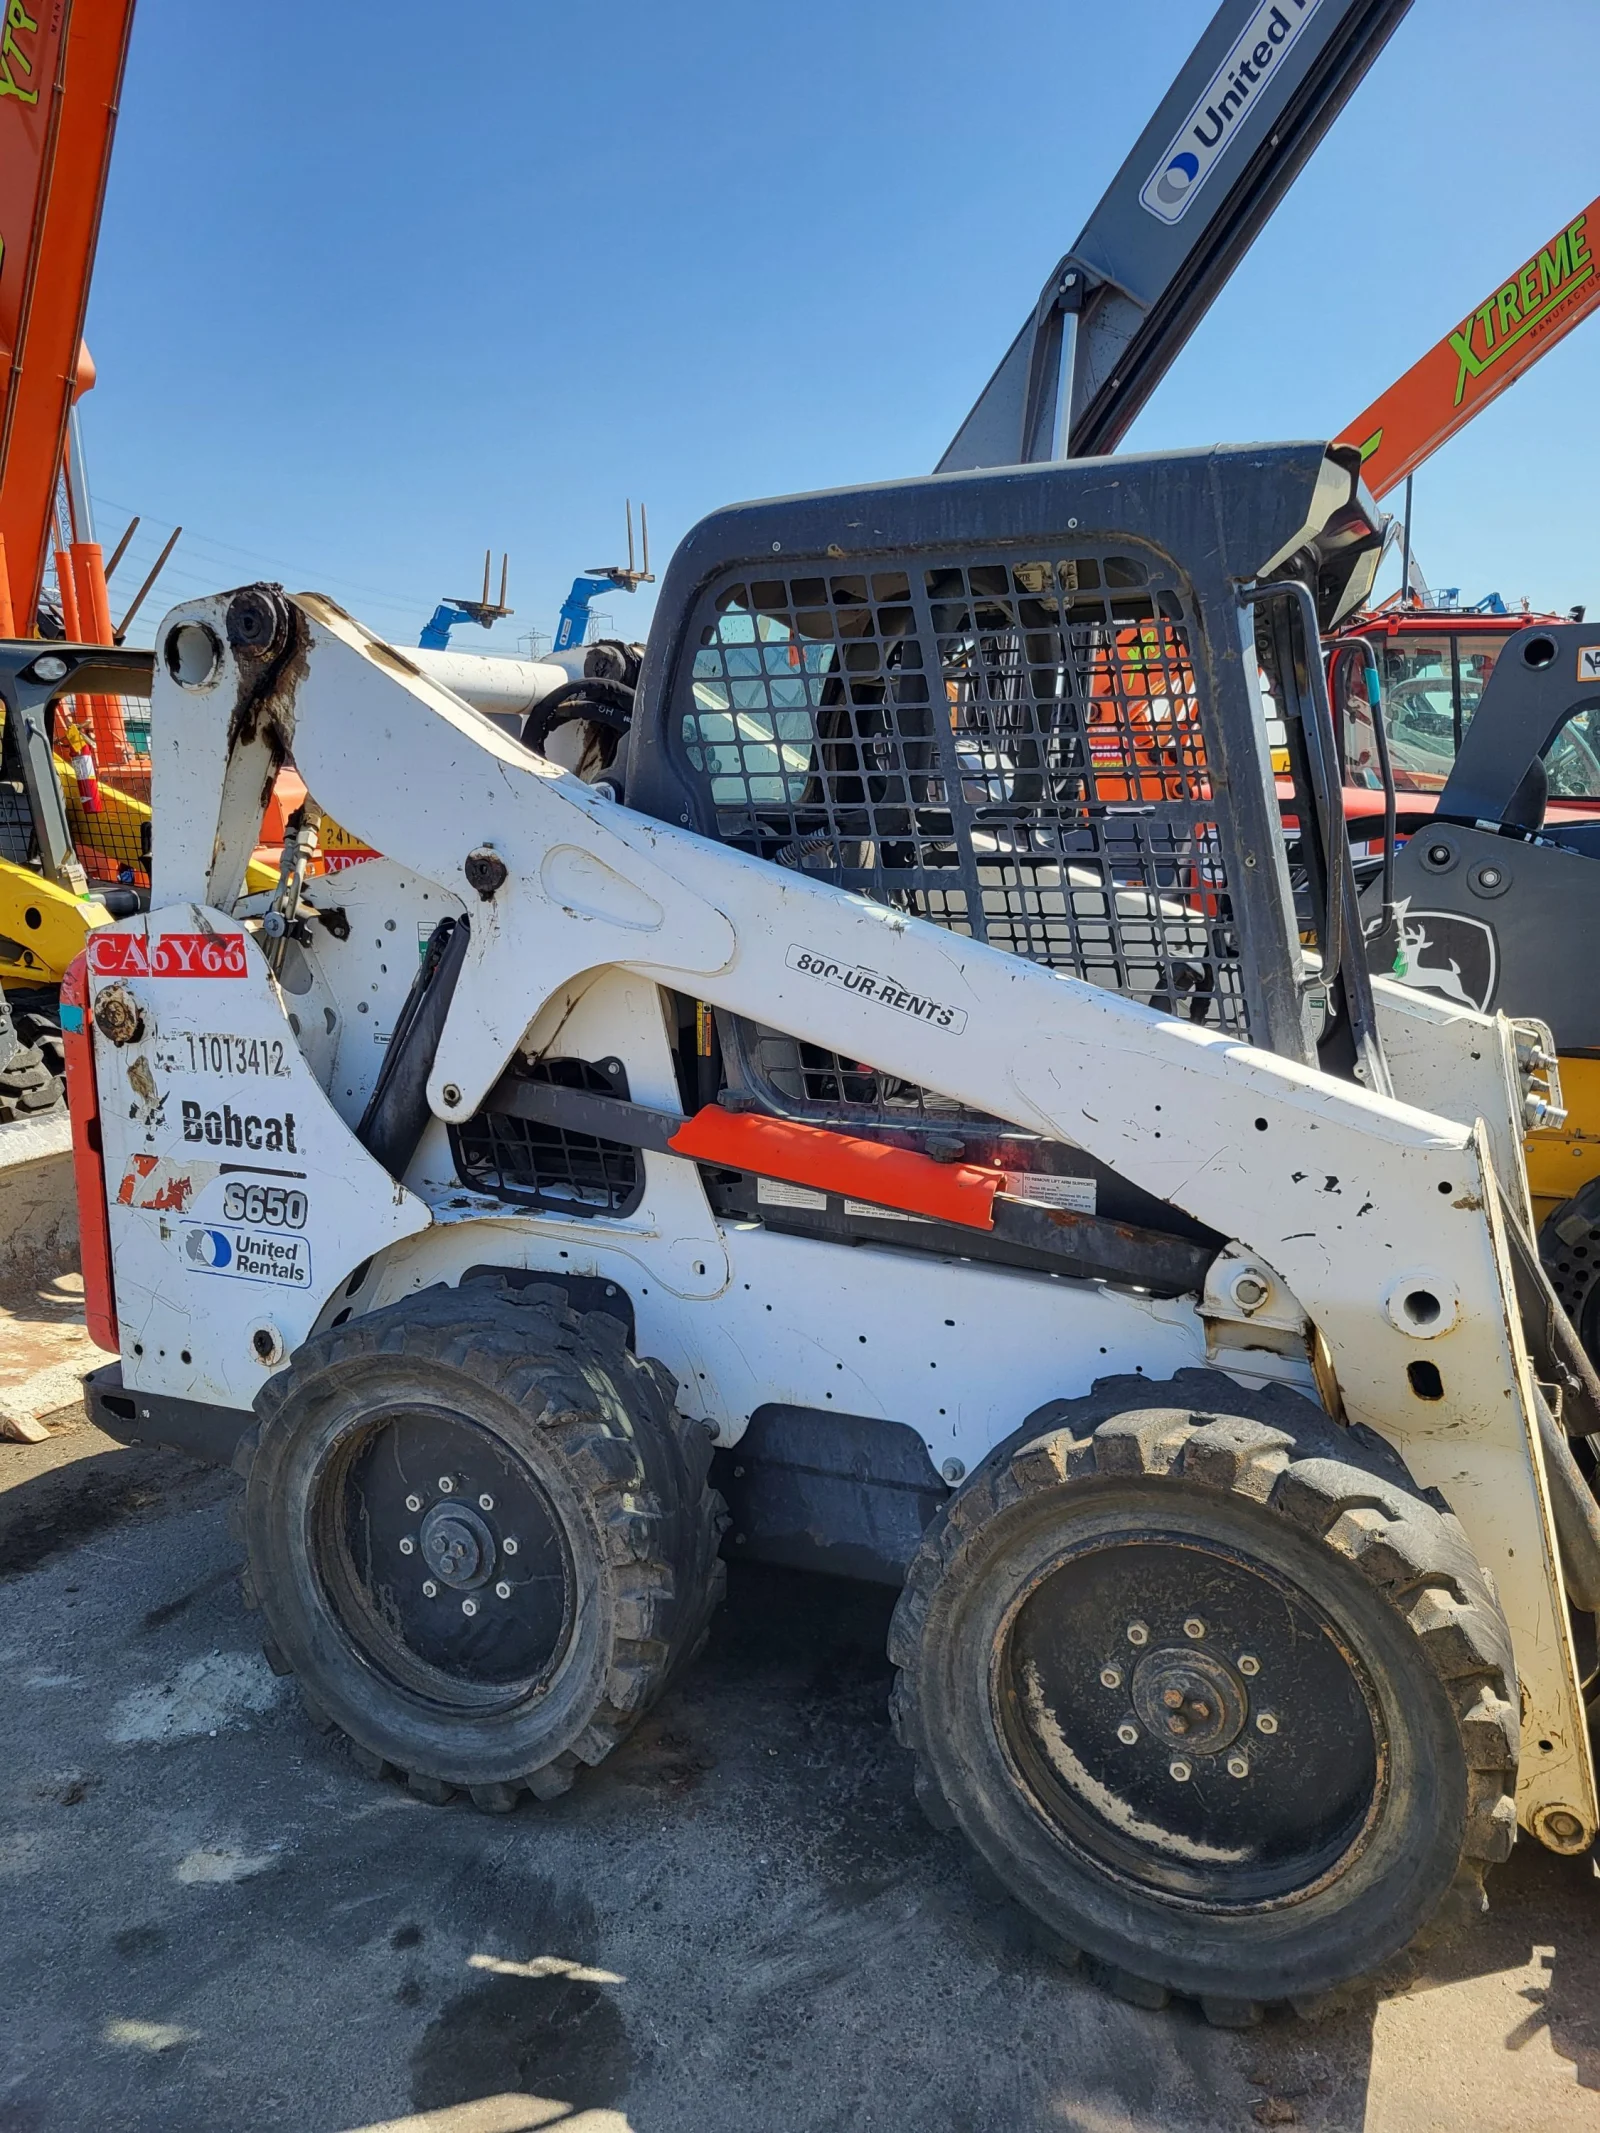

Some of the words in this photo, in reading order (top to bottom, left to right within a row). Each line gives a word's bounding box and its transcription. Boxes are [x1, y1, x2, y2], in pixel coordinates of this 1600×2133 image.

[1193, 6, 1292, 148] United
[1448, 213, 1592, 407] XTREME
[89, 937, 245, 973] CA6Y66
[796, 953, 955, 1026] 800-UR-RENTS
[186, 1036, 284, 1077] 11013412
[181, 1099, 298, 1154] Bobcat
[223, 1182, 308, 1229] S650
[235, 1235, 299, 1261] United
[236, 1254, 305, 1281] Rentals
